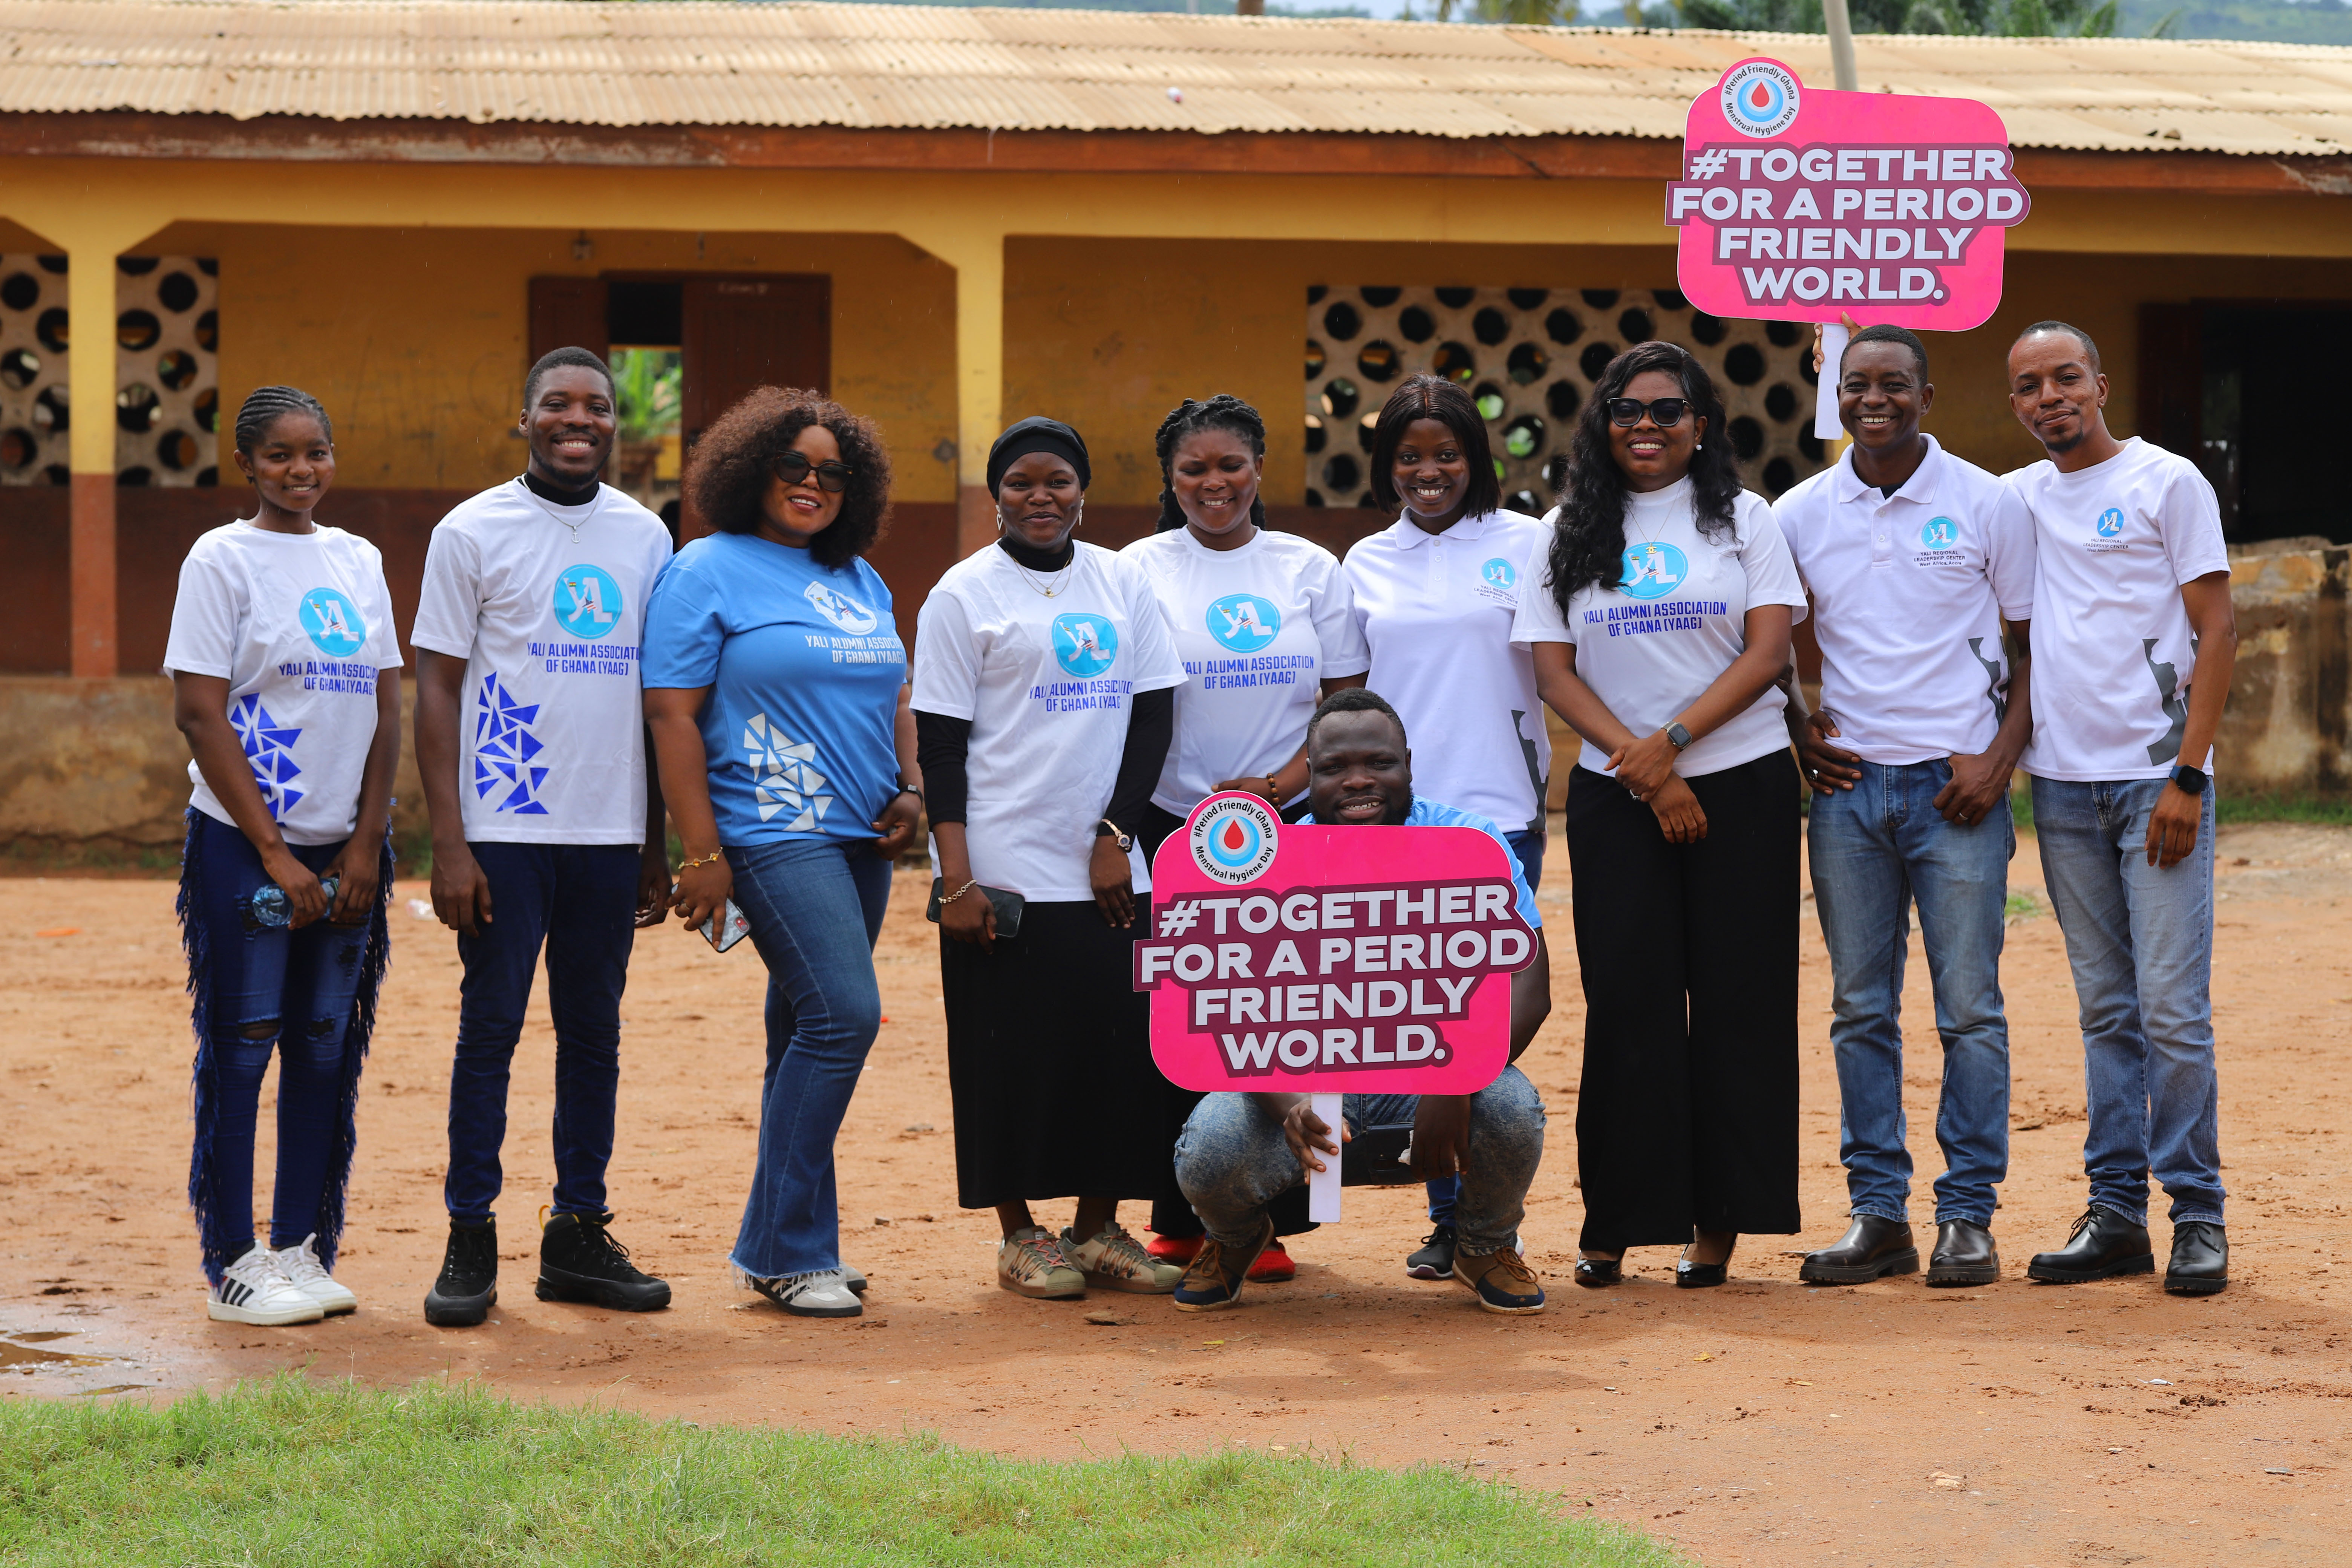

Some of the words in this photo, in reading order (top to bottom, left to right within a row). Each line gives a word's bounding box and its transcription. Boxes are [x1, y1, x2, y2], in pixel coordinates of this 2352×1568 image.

[1724, 68, 1747, 95] #Period
[1747, 65, 1781, 79] Friendly
[1780, 75, 1795, 100] Ghana
[1726, 102, 1754, 133] Menstrual
[1755, 120, 1786, 136] Hygiene
[1783, 106, 1796, 121] Day
[1690, 148, 2008, 182] #TOGETHER
[1672, 187, 1774, 220] FOR
[1783, 188, 1822, 220] A
[1833, 187, 2024, 221] PERIOD
[1719, 228, 1974, 260] FRIENDLY
[1742, 266, 1944, 300] WORLD.
[1474, 588, 1503, 597] LEADERSHIP
[1493, 588, 1514, 599] REGIONAL
[1583, 609, 1603, 624] YALI
[1608, 605, 1651, 621] ALUMNI
[1654, 602, 1726, 617] ASSOCIATION
[1608, 623, 1621, 637] OF
[1624, 619, 1661, 635] GHANA
[527, 643, 545, 656] YALI
[548, 644, 588, 657] ALUMNI
[805, 635, 828, 648] YALI
[830, 637, 867, 649] ALUMNI
[546, 660, 559, 672] OF
[562, 660, 596, 674] GHANA
[831, 650, 844, 663] OF
[845, 651, 877, 664] GHANA
[1206, 658, 1248, 674] ALUMNI
[1251, 655, 1314, 671] ASSOCIATION
[279, 663, 302, 675] YALI
[306, 662, 340, 676] ALUMNI
[304, 677, 317, 690] OF
[320, 678, 345, 692] GHANA
[1049, 682, 1087, 697] ALUMNI
[1205, 676, 1217, 689] OF
[1220, 674, 1257, 688] GHANA
[1046, 698, 1058, 711] OF
[1061, 697, 1096, 711] GHANA
[1194, 805, 1218, 838] #Period
[1218, 801, 1256, 816] Friendly
[1255, 811, 1272, 839] Ghana
[1196, 846, 1228, 879] Menstrual
[1230, 863, 1263, 882] Hygiene
[1260, 847, 1274, 863] Day
[1158, 884, 1513, 937] #TOGETHER
[1141, 942, 1254, 983] FOR
[1264, 939, 1307, 978] A
[1318, 928, 1530, 975] PERIOD
[1194, 975, 1476, 1026] FRIENDLY
[1221, 1024, 1446, 1071] WORLD.
